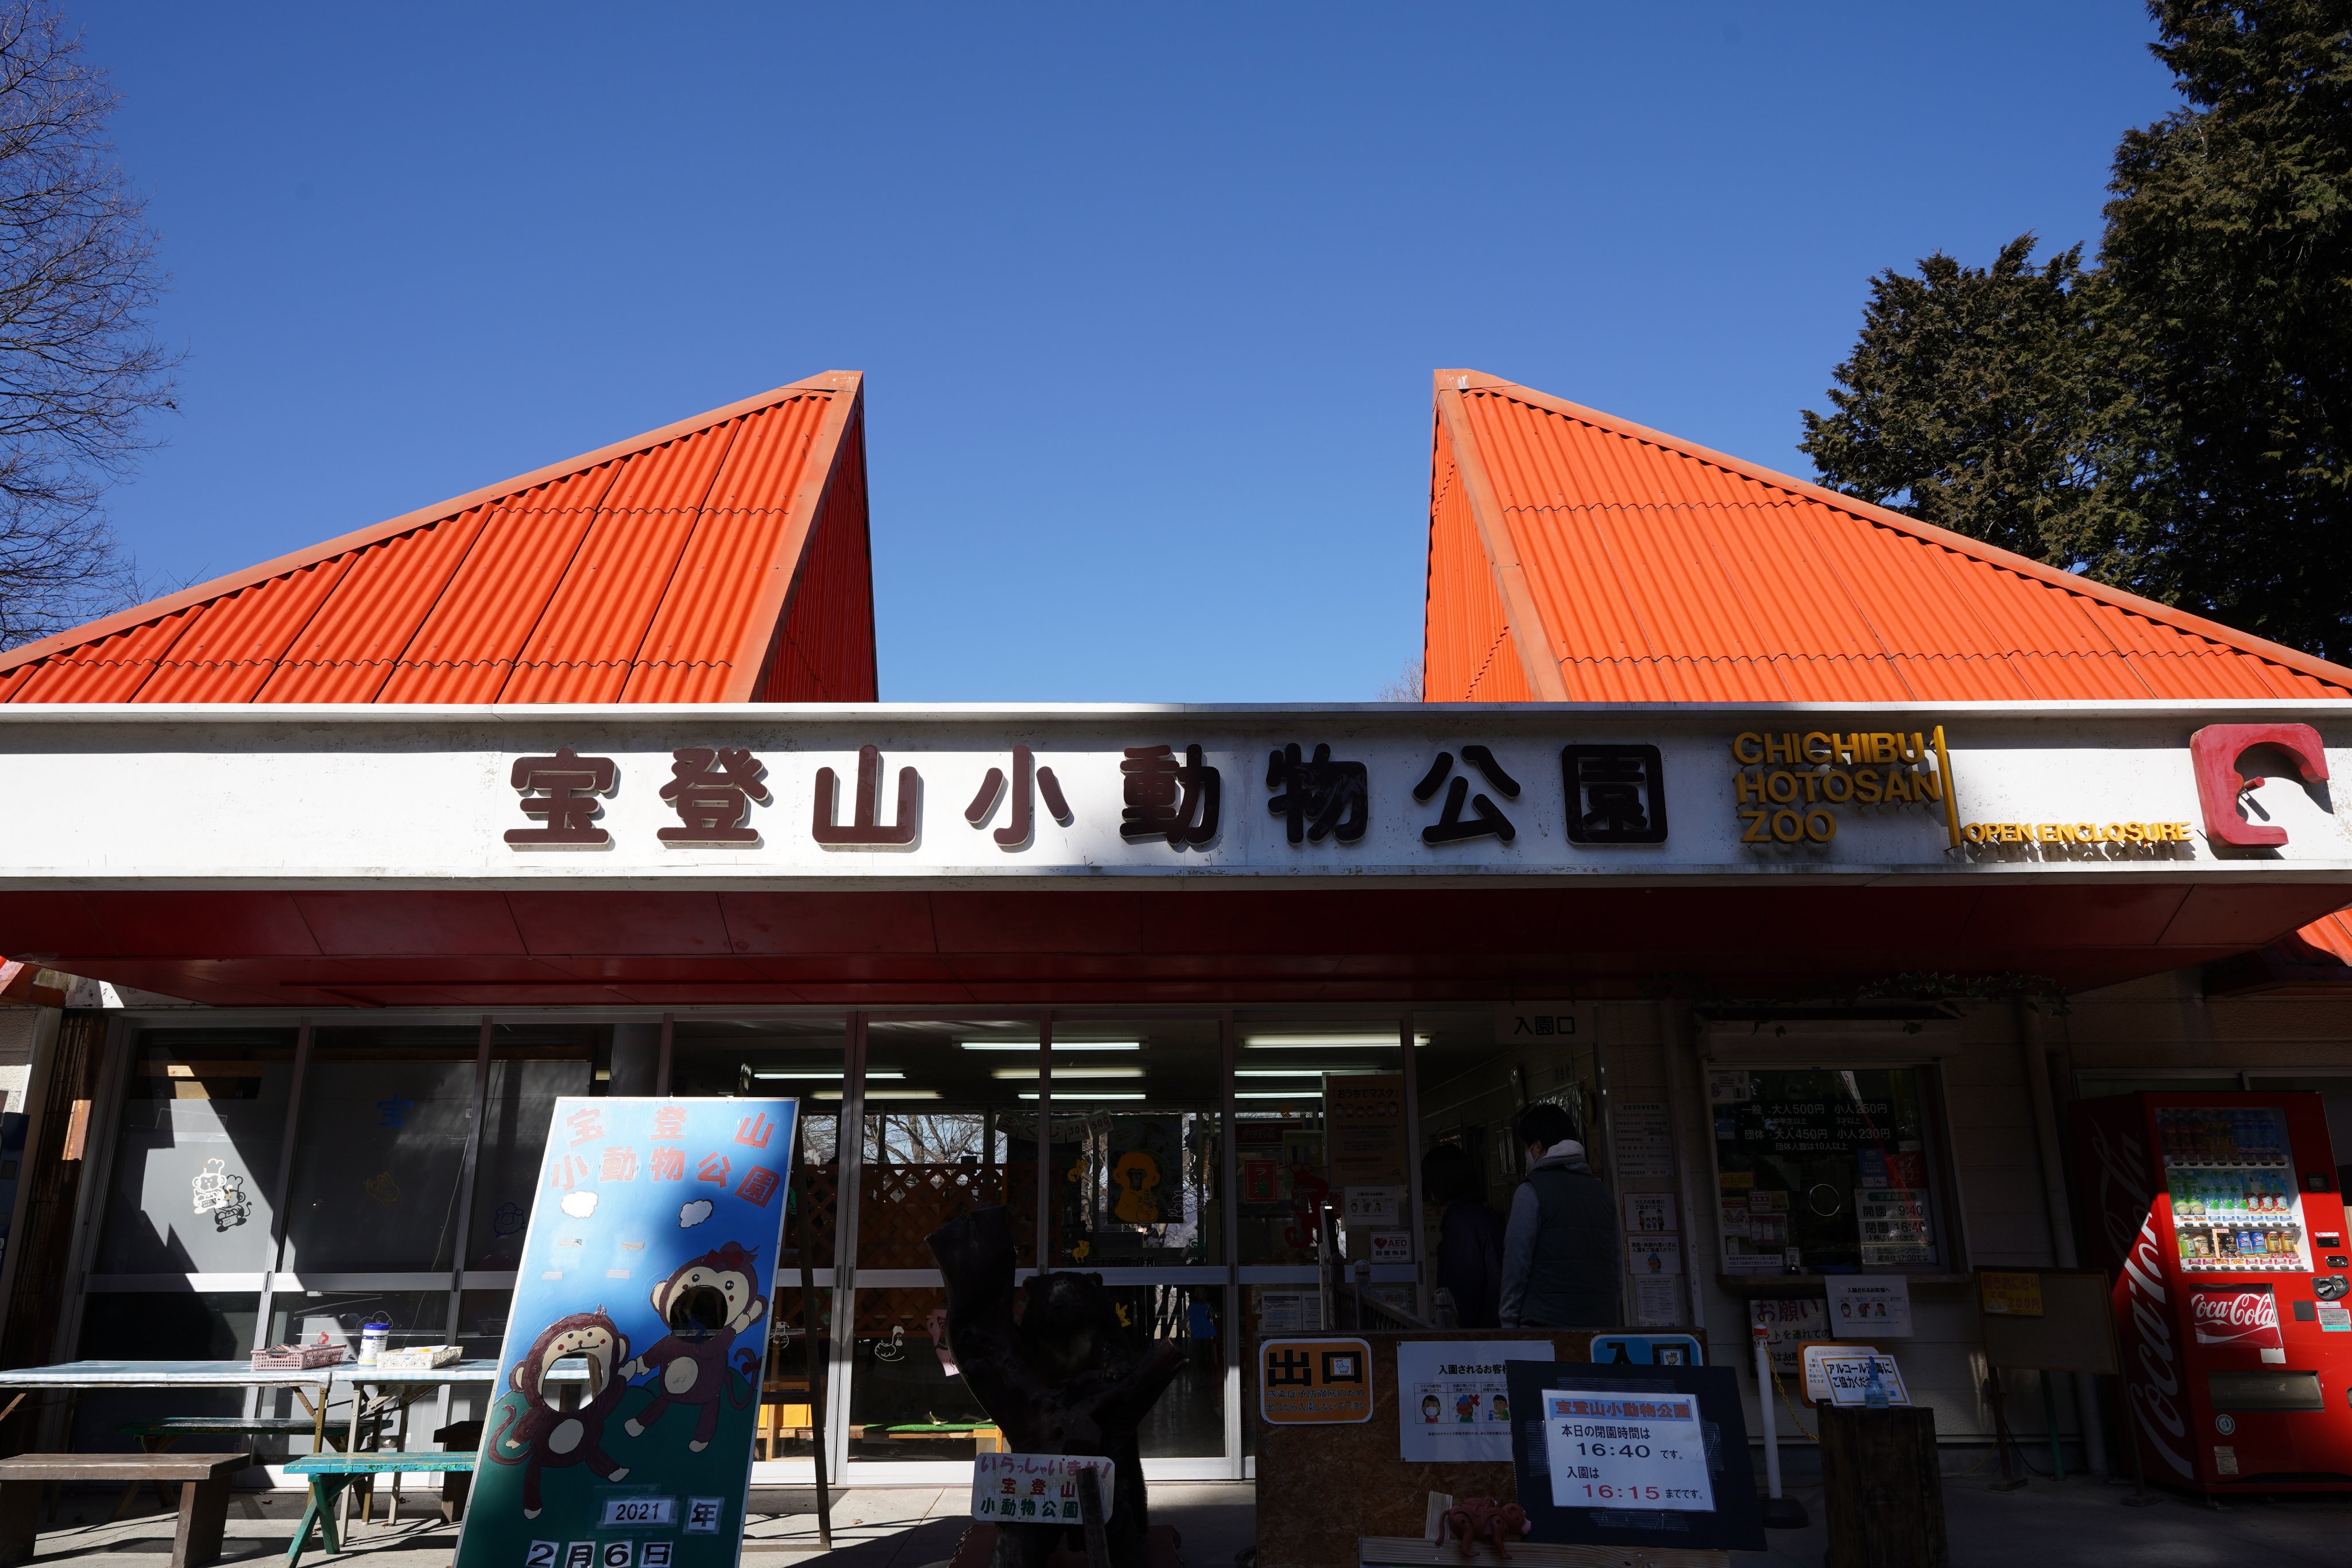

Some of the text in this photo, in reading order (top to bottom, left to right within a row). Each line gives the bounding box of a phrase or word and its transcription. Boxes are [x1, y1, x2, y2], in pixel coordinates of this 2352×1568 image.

[1733, 731, 1925, 765] CHICHIBU
[503, 743, 1668, 846] 宝登山小動物公園
[1734, 770, 1942, 805] HOTOSAN
[1740, 808, 1838, 845] ZOO
[1961, 821, 2195, 845] OPEN ENCLOSURE
[1514, 1015, 1576, 1036] 入園口
[1741, 1103, 1762, 1115] 一般
[1771, 1103, 1825, 1115] 大人500円
[567, 1106, 775, 1149] 宝登山
[1744, 1128, 1891, 1140] 団体 大人450円 小人230円
[1775, 1141, 1848, 1151] 団体人数は10人以上
[551, 1145, 780, 1208] 小動物公園
[1863, 1205, 1923, 1217] 開園 9:40
[1865, 1222, 1889, 1233] 閉園
[1755, 1299, 1819, 1322] お願い
[2191, 1293, 2277, 1326] Coca-Cola
[1267, 1349, 1363, 1388] 出口
[1266, 1401, 1369, 1413] 出口から入園しないで下さい
[1554, 1399, 1691, 1419] 宝登山小動物公園
[1561, 1424, 1651, 1439] 本日の閉園時間は
[1576, 1442, 1684, 1460] 16:40 です。
[1566, 1466, 1600, 1479] 入園は
[1000, 1477, 1076, 1498] 宝登山
[1582, 1484, 1703, 1500] 16:15 までです。
[980, 1497, 1078, 1518] 小動物公園
[527, 1544, 671, 1568] 2月6日
